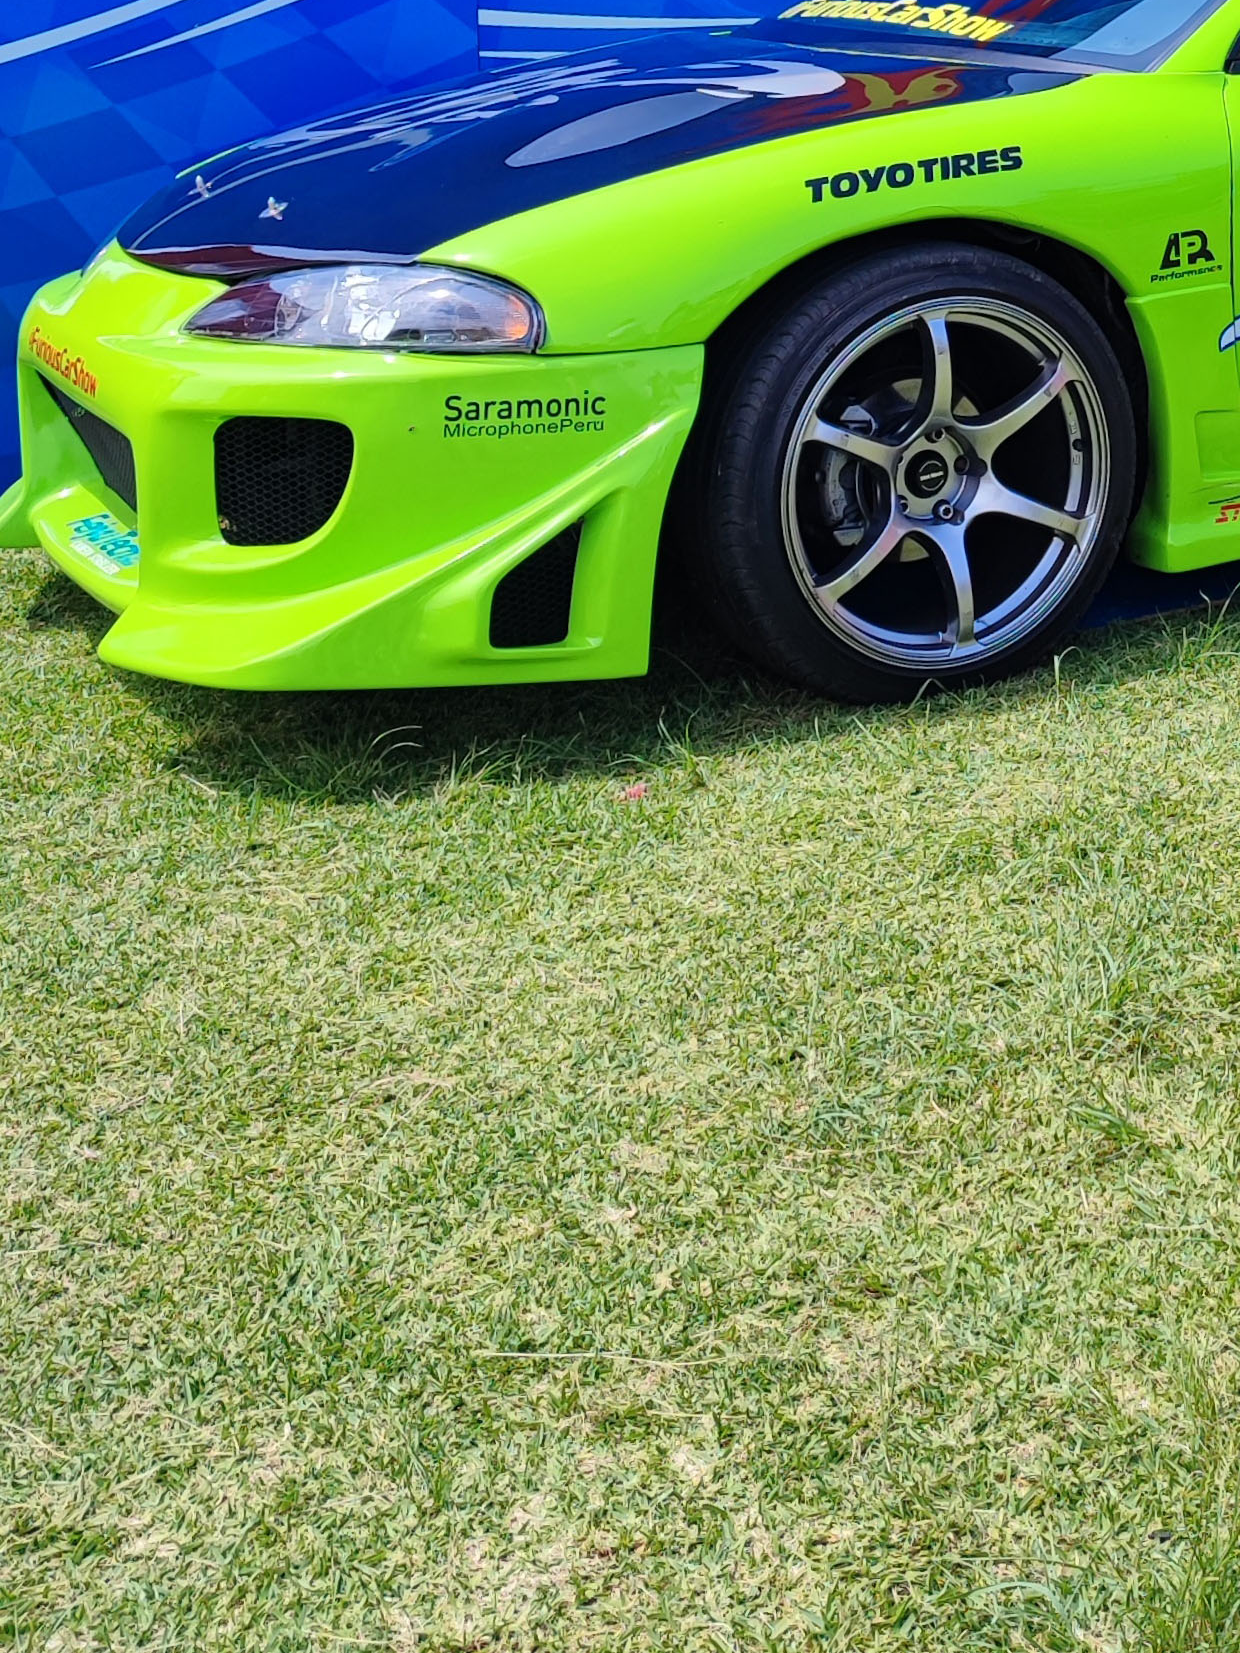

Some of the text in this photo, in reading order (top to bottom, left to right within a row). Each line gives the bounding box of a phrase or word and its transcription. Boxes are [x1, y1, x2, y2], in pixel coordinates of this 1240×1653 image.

[804, 145, 1024, 204] TOYO TIRES
[443, 389, 607, 422] Saramonic
